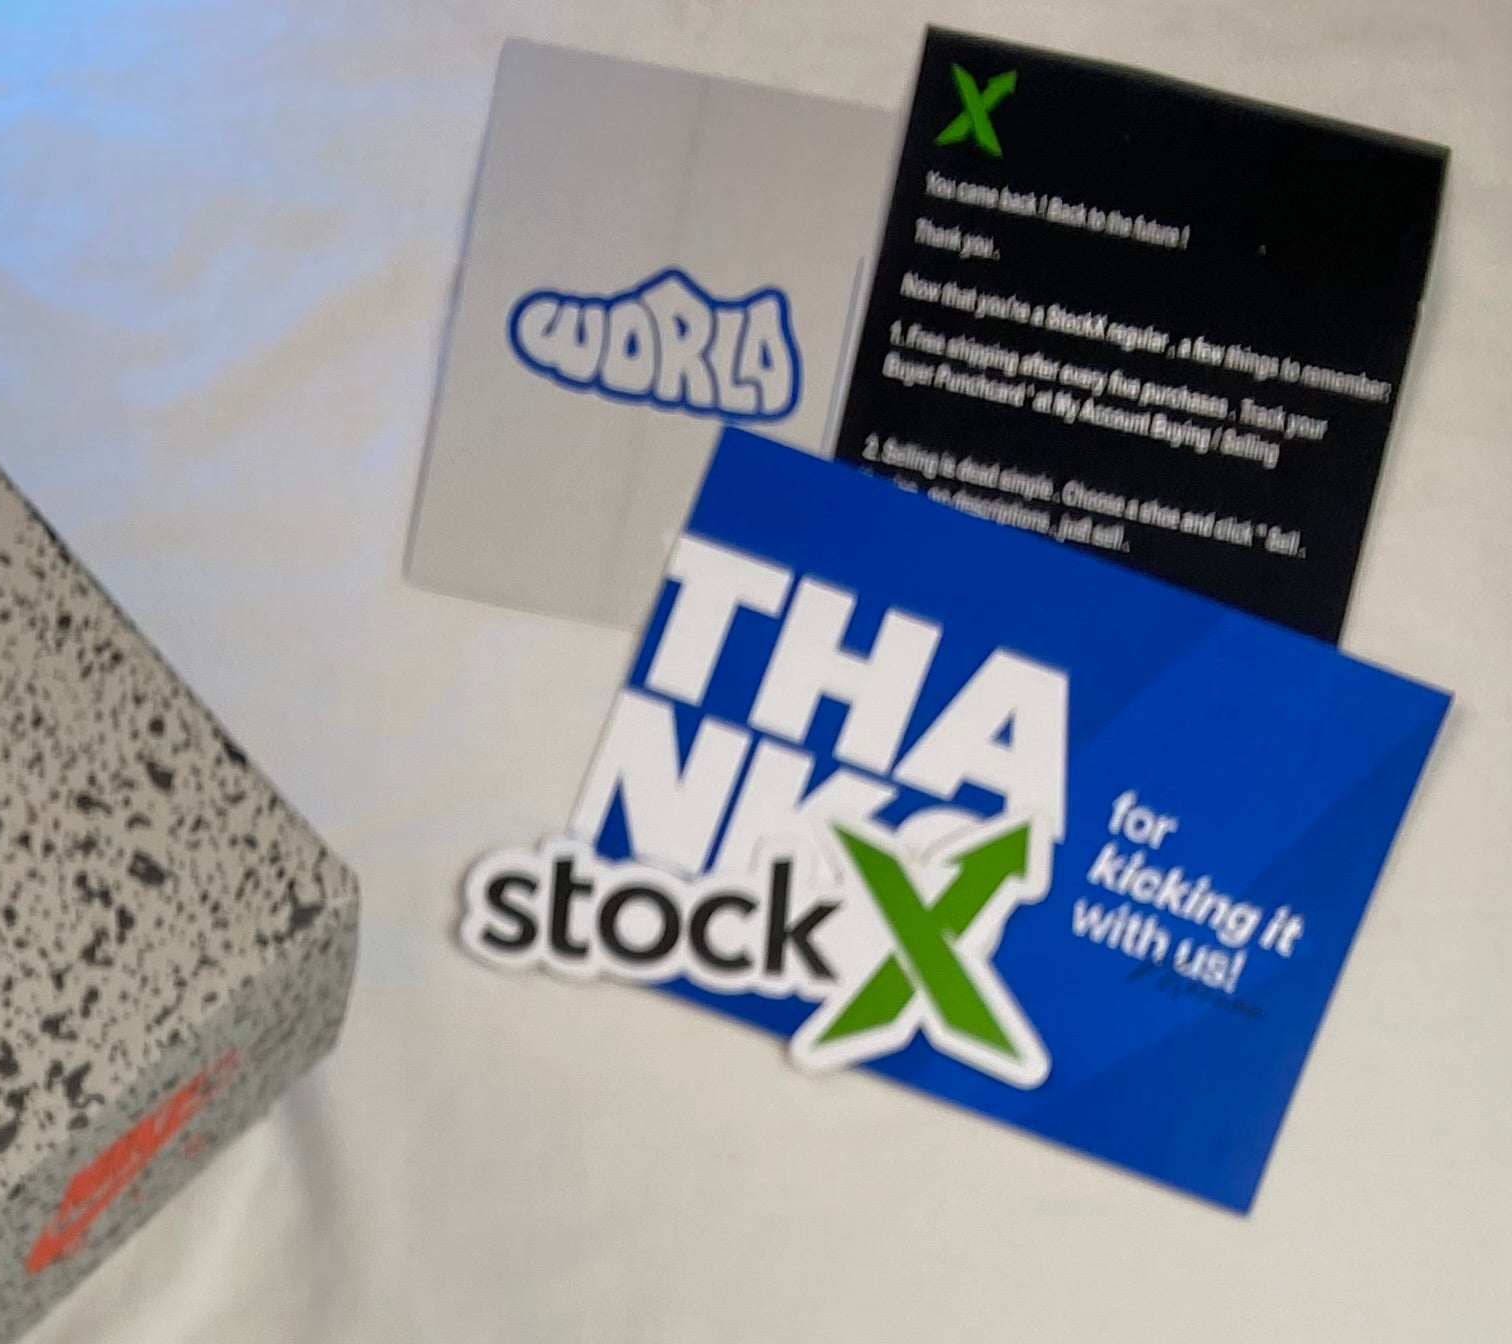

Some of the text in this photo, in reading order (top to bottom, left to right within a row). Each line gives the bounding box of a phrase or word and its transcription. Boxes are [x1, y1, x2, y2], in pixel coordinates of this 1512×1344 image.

[665, 533, 1070, 843] THA
[1108, 789, 1180, 850] for
[1071, 896, 1171, 966] with
[1173, 937, 1248, 995] us!
[1086, 841, 1305, 958] kicking it
